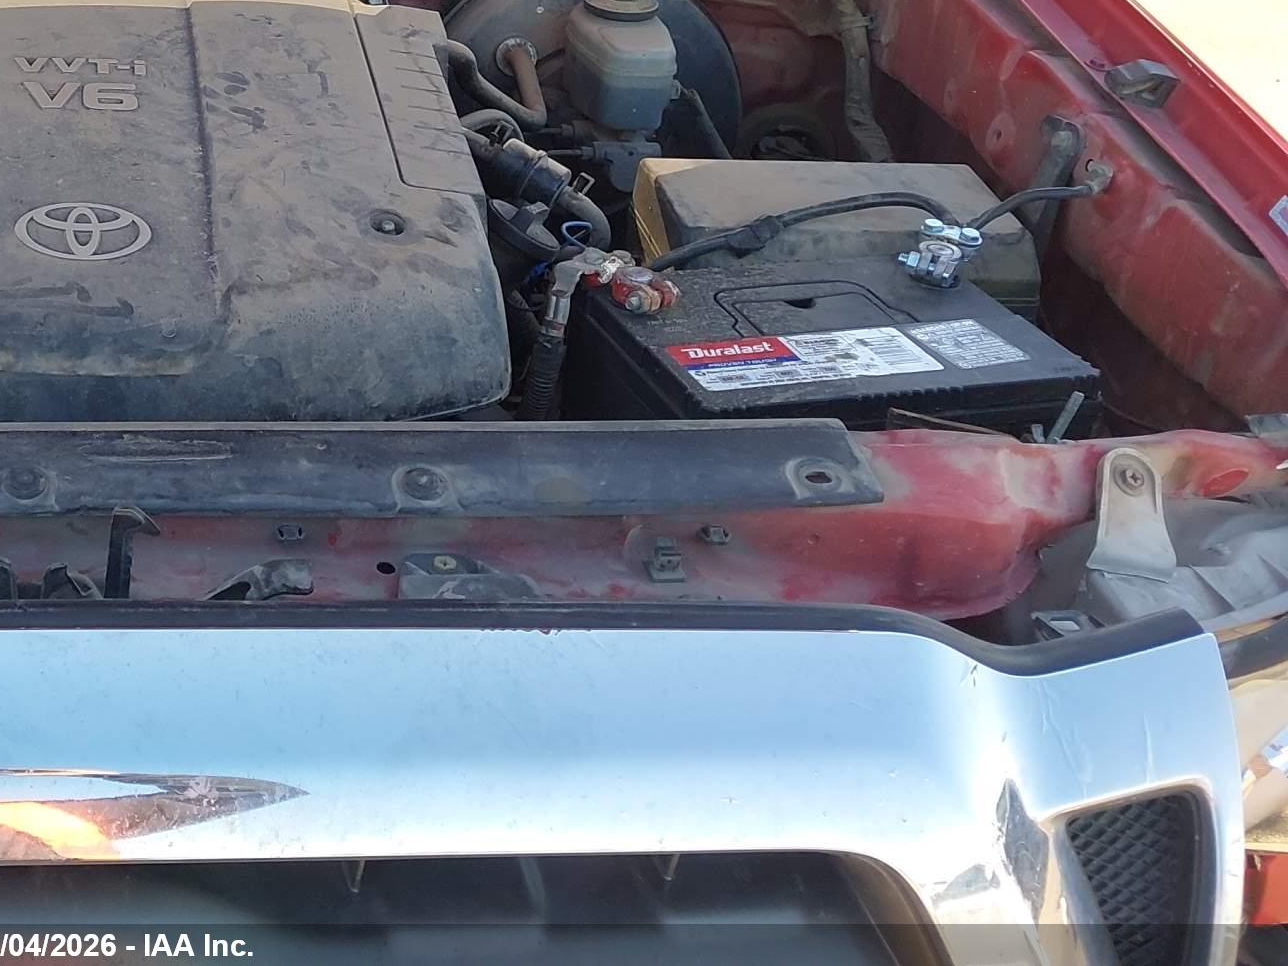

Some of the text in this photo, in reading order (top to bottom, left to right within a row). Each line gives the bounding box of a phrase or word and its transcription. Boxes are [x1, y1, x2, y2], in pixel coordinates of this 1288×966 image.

[14, 56, 148, 76] VVT-i
[21, 81, 139, 111] V6
[681, 341, 775, 359] Duralast
